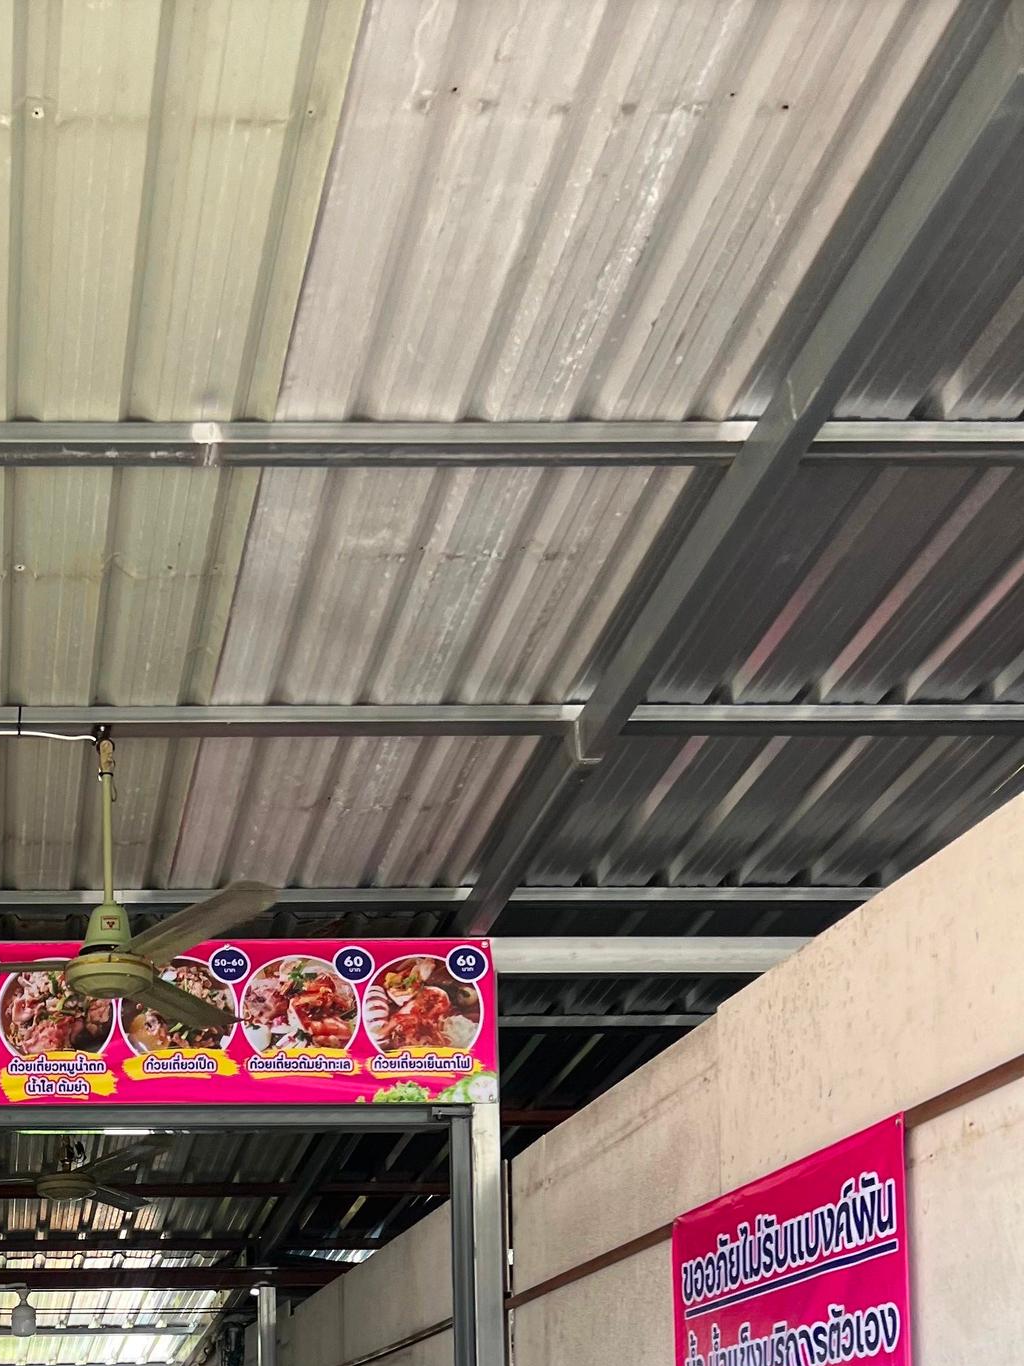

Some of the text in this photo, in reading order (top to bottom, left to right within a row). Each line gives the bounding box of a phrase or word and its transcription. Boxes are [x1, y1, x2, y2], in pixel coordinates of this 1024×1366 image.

[214, 959, 244, 967] 50-60
[344, 956, 363, 967] 60
[456, 955, 476, 966] 60
[28, 1078, 88, 1093] น้ำใส ต้มยำ
[683, 1176, 895, 1302] ขออภัยไม่รับแบงค์พัน
